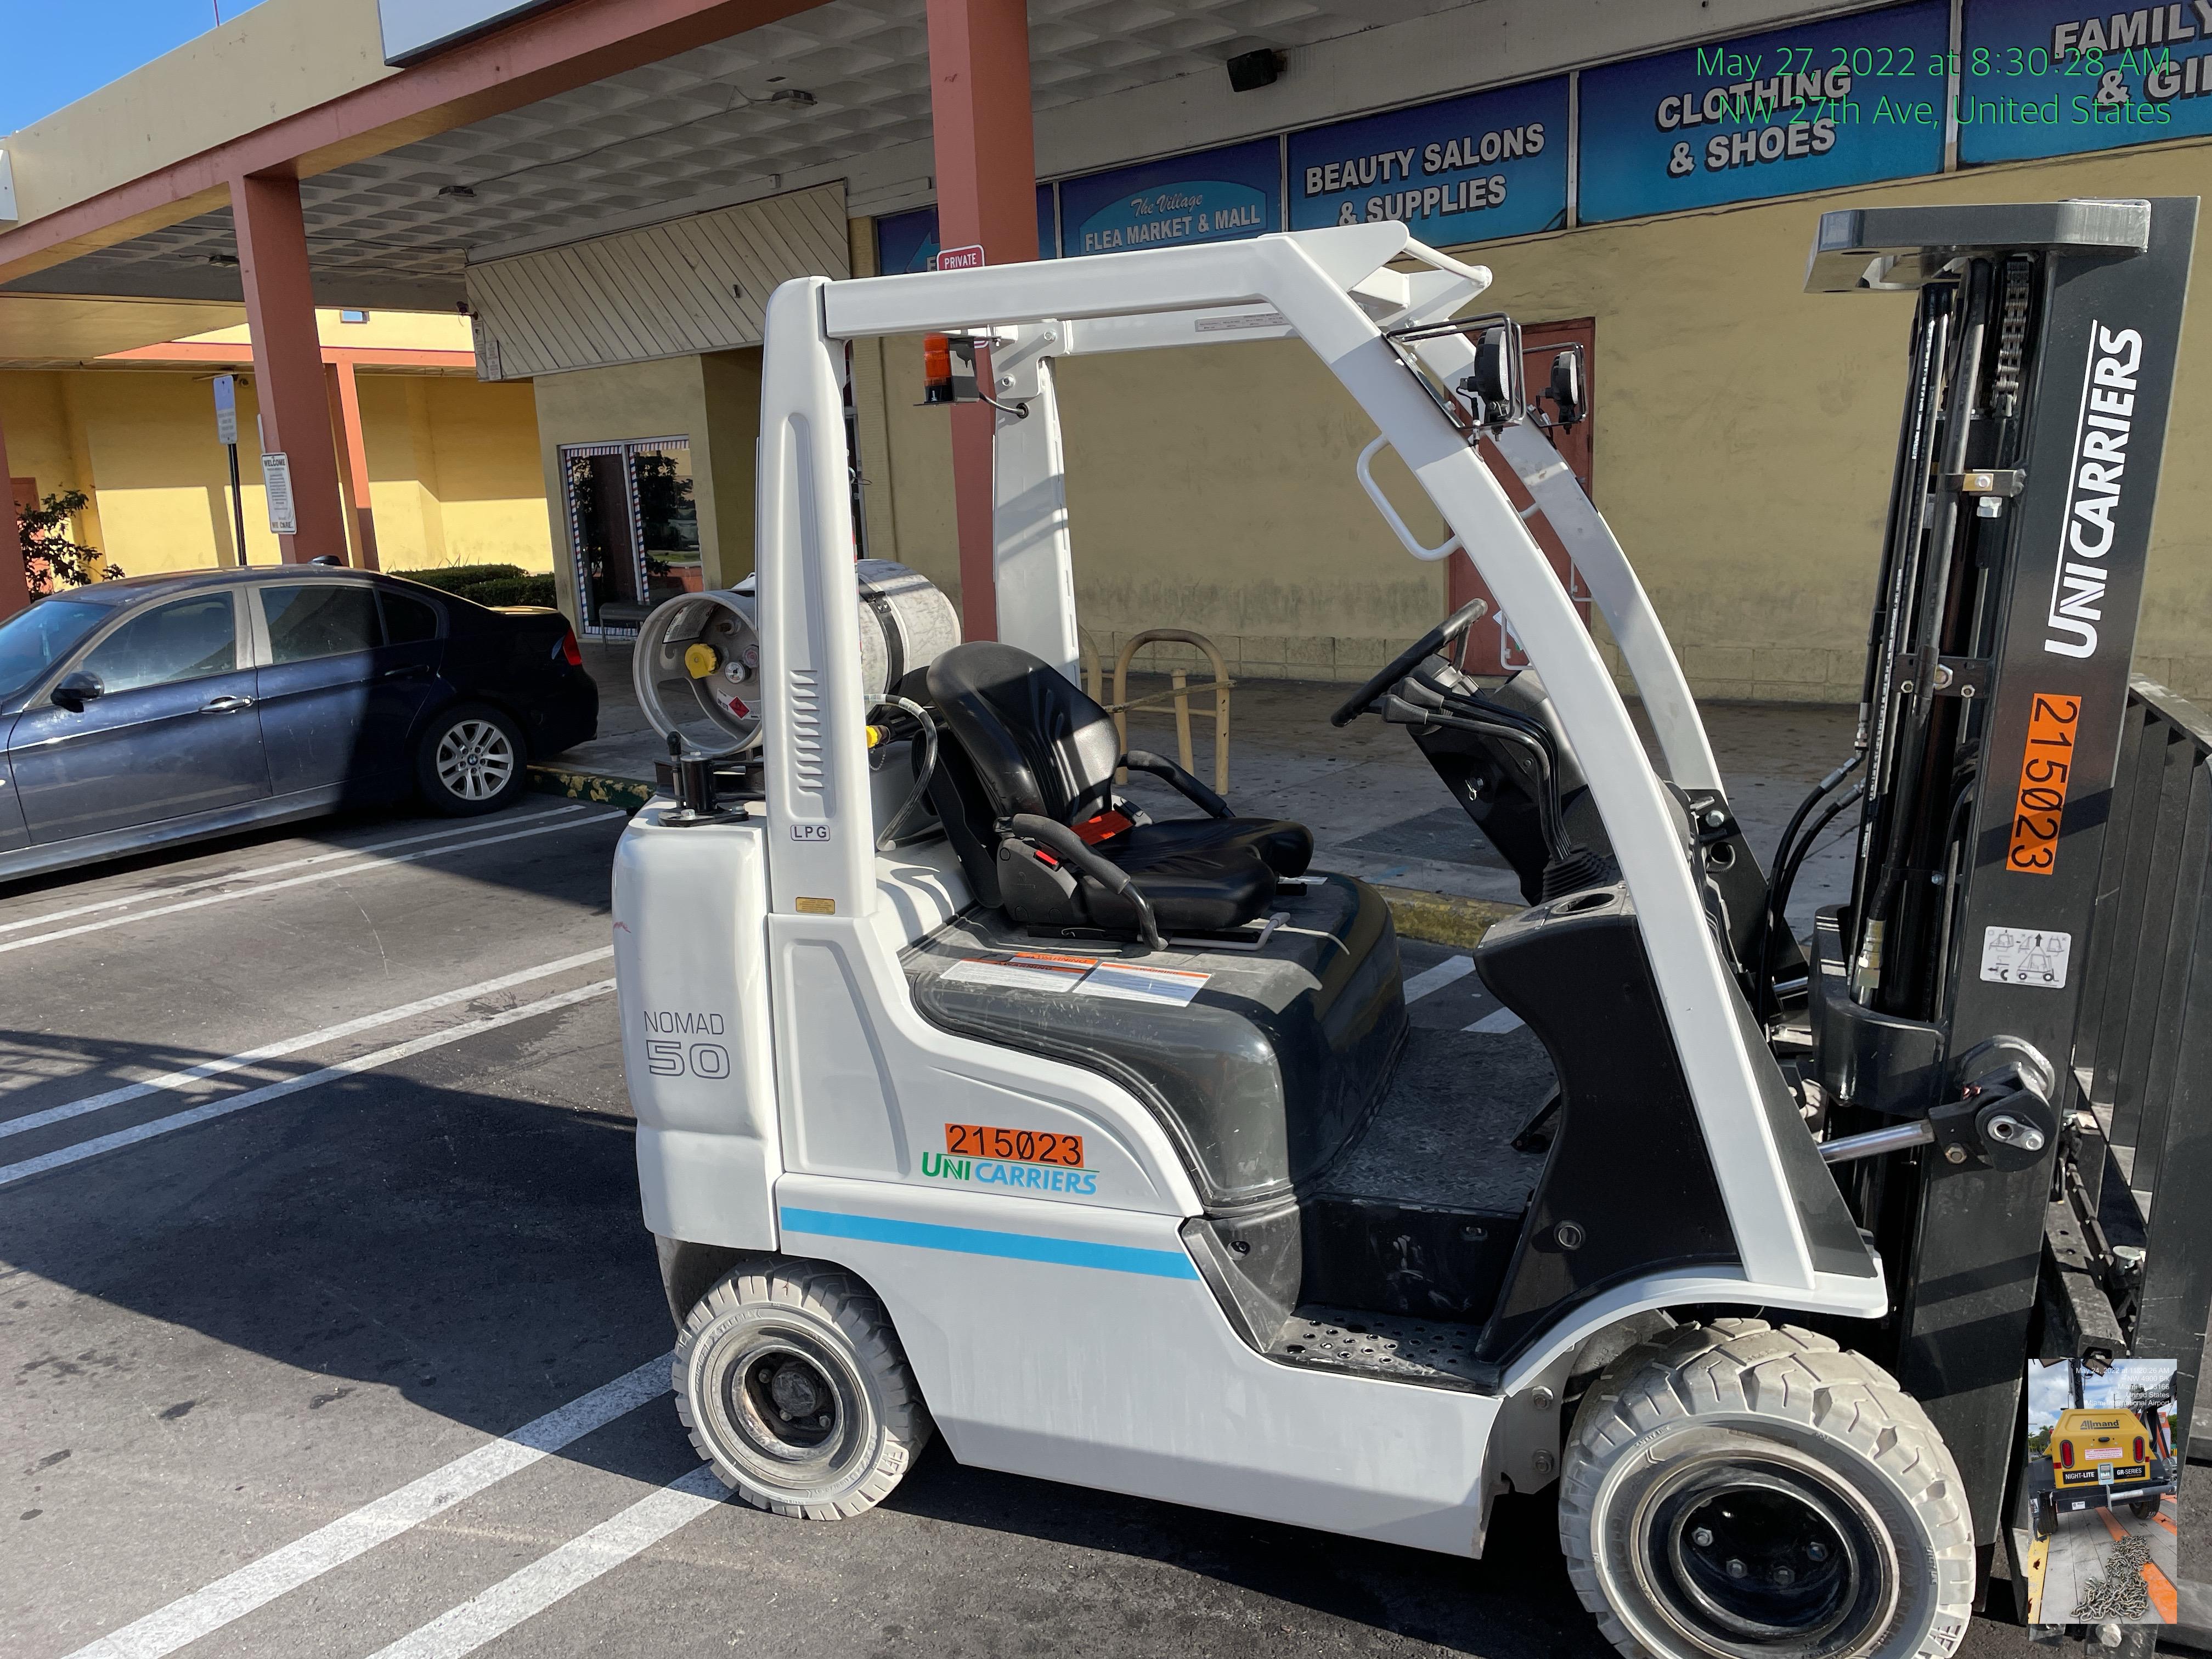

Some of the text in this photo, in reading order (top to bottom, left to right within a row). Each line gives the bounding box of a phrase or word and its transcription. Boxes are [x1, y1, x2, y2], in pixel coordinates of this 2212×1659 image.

[1657, 65, 1852, 128] CLOTHING
[2097, 71, 2129, 106] &
[1306, 123, 1545, 194] BEAUTY SALONS
[1669, 117, 1836, 174] & SHOES
[1131, 193, 1203, 217] The Village
[1339, 175, 1506, 225] & SUPPLIES
[1085, 205, 1260, 252] FLEA MARKET & MALL
[944, 253, 977, 269] PRIVATE
[2011, 697, 2078, 868] 215023
[794, 826, 827, 839] LPG
[644, 1011, 724, 1035] NOMAD
[646, 1039, 730, 1080] 50
[949, 1125, 1081, 1165] 215023
[2080, 1420, 2119, 1430] Allmand
[2065, 1471, 2095, 1480] NIGHT-LITE
